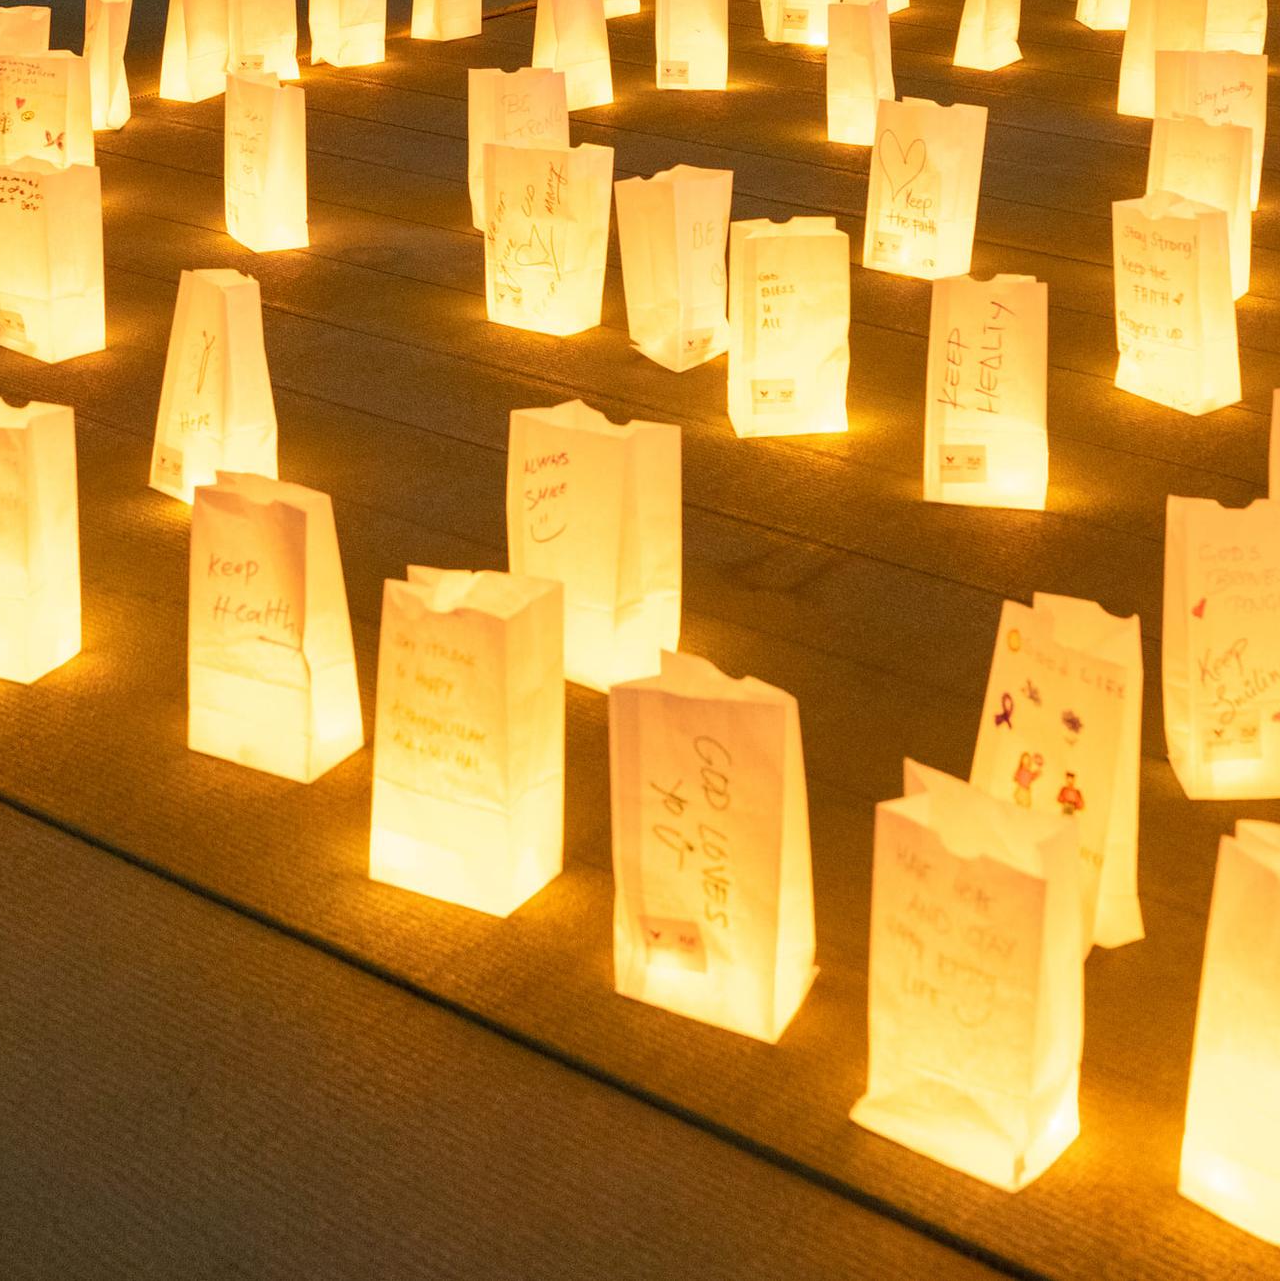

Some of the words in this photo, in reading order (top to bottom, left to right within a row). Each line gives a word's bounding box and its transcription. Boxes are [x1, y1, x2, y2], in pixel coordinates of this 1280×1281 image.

[936, 327, 970, 411] KEEP
[693, 735, 733, 812] GOD
[697, 822, 732, 929] LOVES
